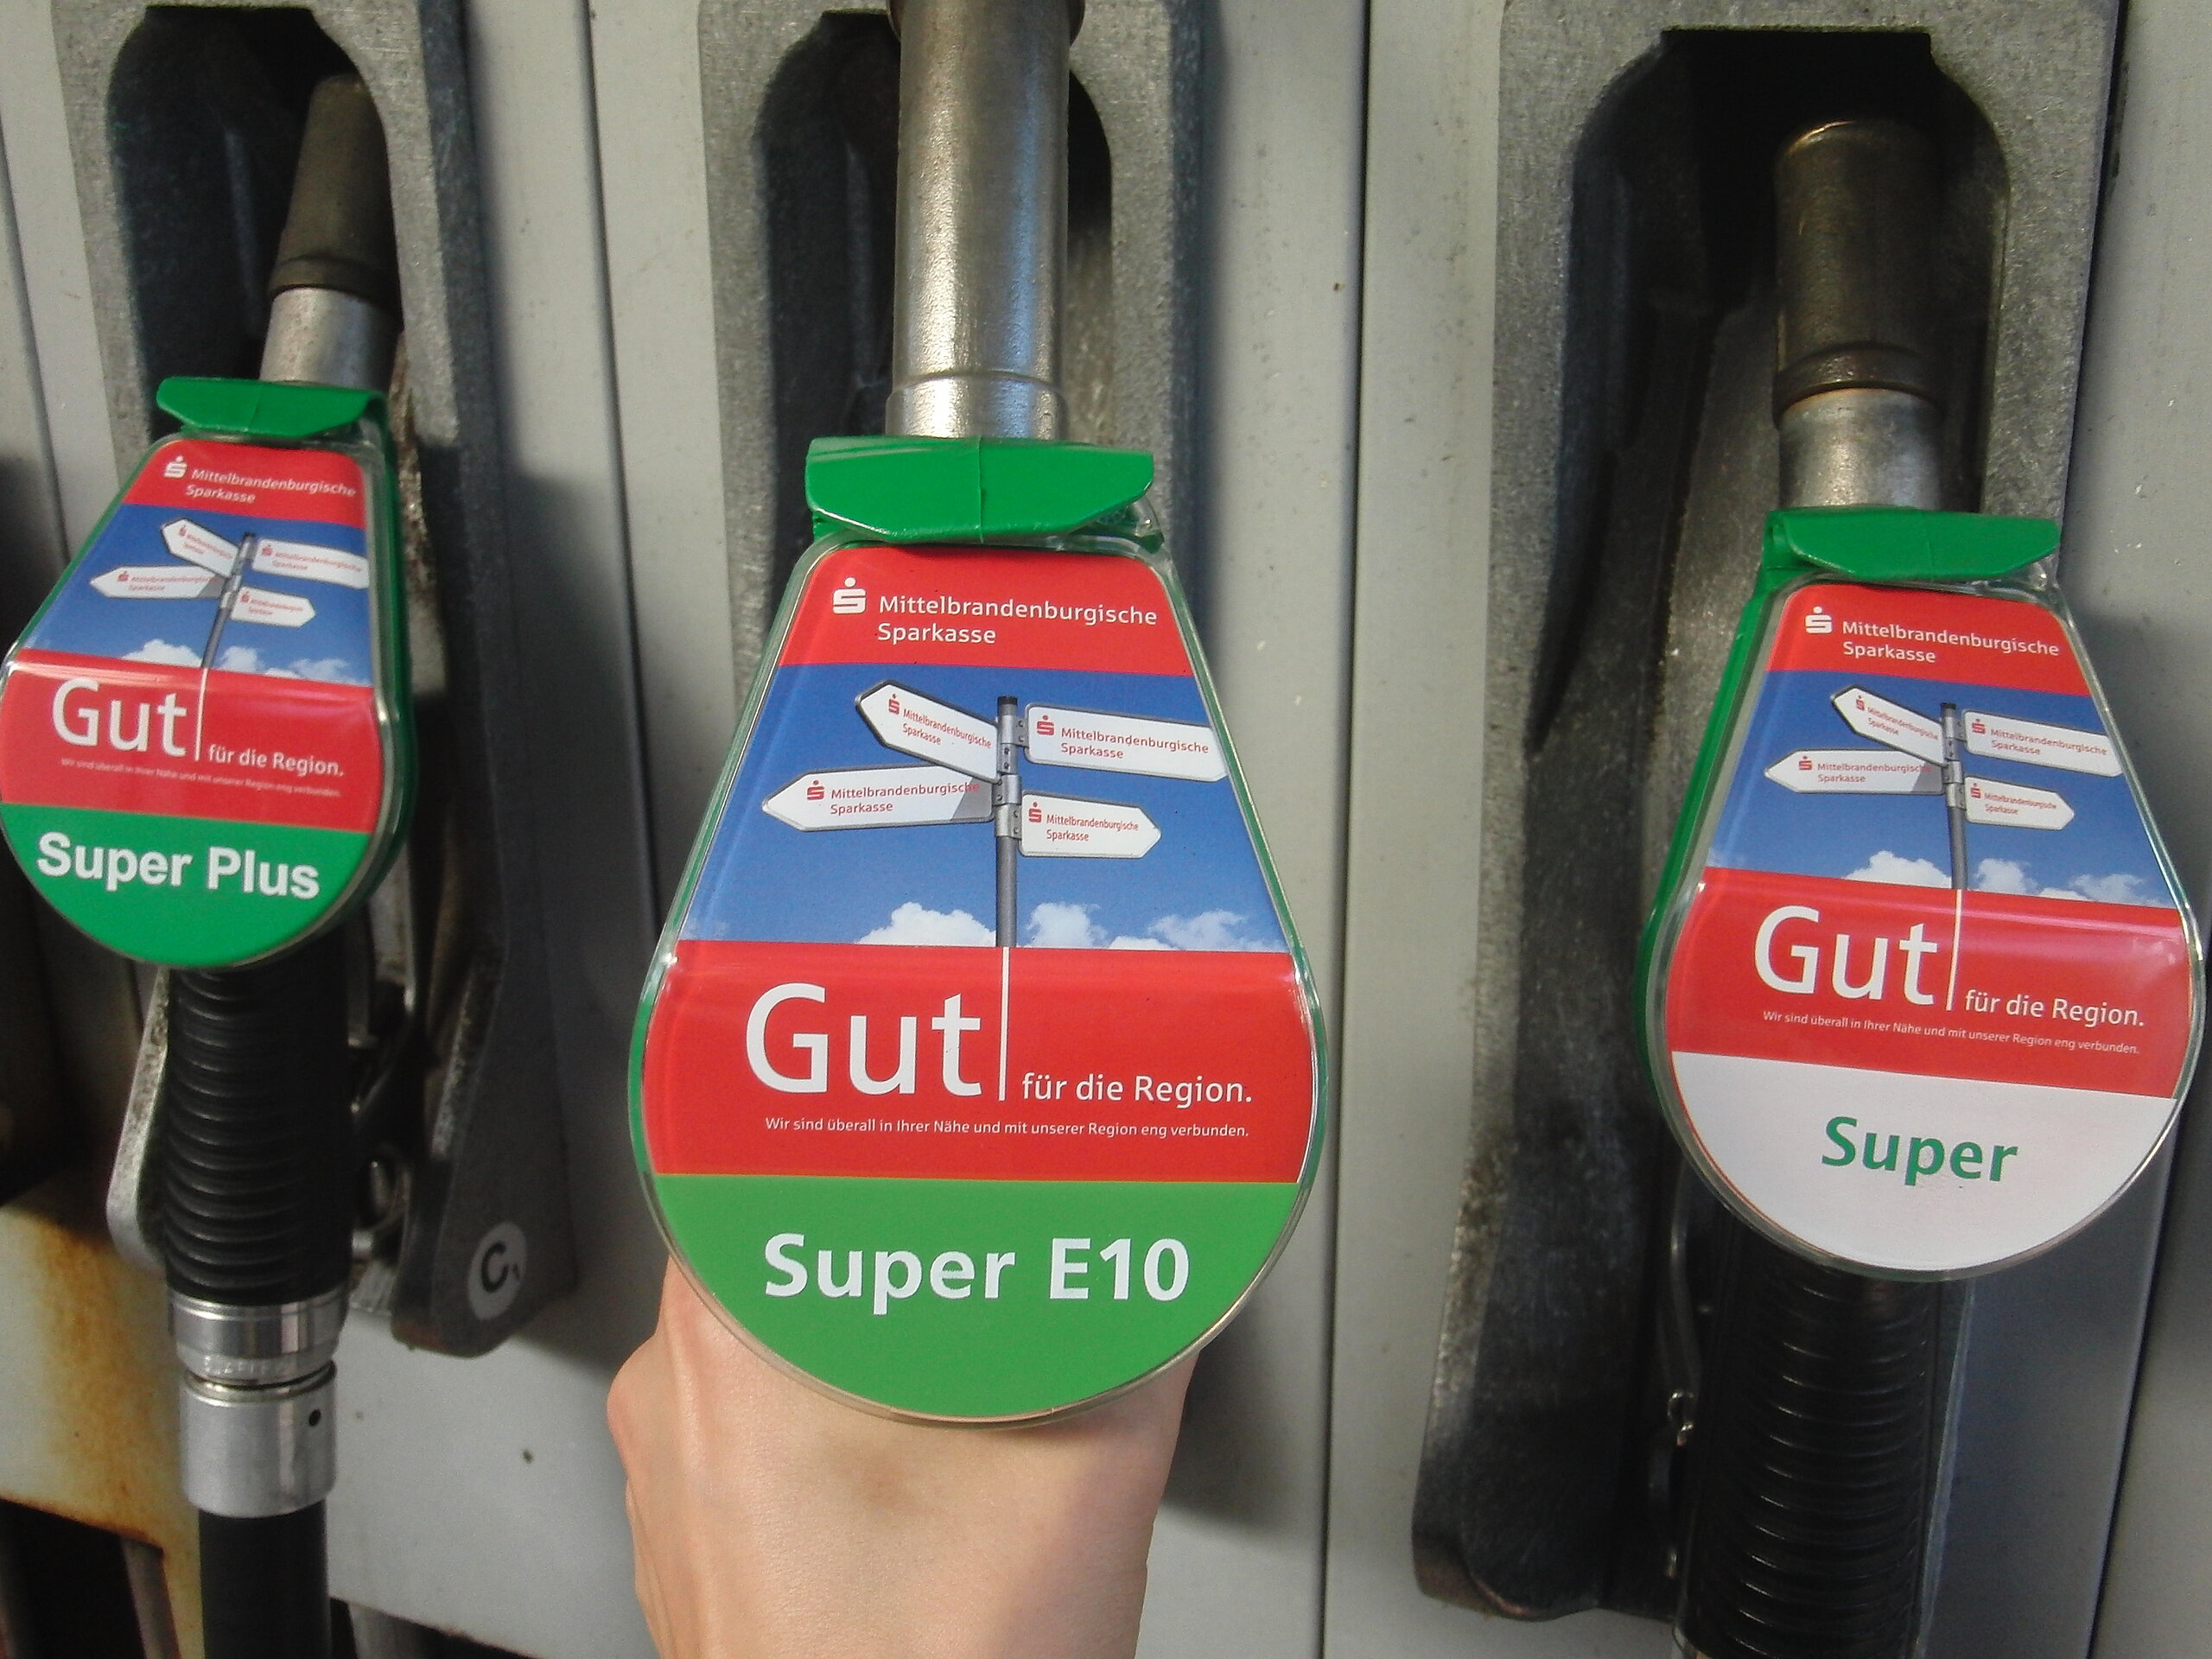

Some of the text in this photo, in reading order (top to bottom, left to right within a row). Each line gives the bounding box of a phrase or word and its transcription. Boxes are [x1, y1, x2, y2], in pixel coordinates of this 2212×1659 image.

[186, 484, 256, 503] Sparkasse
[192, 469, 356, 497] Mittelbrandenburgische
[879, 594, 1157, 627] Mittelbrandenburgische
[877, 622, 996, 645] Sparkasse
[1842, 620, 2060, 657] Mittelbrandenburgische
[1842, 641, 1936, 664] Sparkasse
[53, 677, 344, 777] Gut für die Region.
[902, 723, 941, 745] Sparkasse
[903, 709, 991, 748] Mittelbrandenburgische
[1061, 728, 1209, 753] Mittelbrandenburgische
[1061, 743, 1123, 759] Sparkasse
[1991, 729, 2107, 755] Mittelbrandenburgische
[1991, 740, 2041, 755] Sparkasse
[1817, 763, 1933, 773] Mittelbrandenburgische
[1817, 774, 1866, 783] Sparkasse
[831, 783, 980, 799] Mittelbrandenburgische
[830, 803, 893, 816] Sparkasse
[1046, 814, 1139, 831] Mittelbrandenburgische
[1046, 830, 1089, 842] Sparkasse
[37, 831, 320, 899] Super Plus
[1754, 905, 2145, 1027] Gut für die Region.
[1764, 1011, 2139, 1054] Wir sind überall in Ihrer Nähe und mit unserer Region eng verbunden.
[747, 982, 1252, 1109] Gut für die Region.
[766, 1117, 1249, 1139] Wir sind überall in Ihrer Nähe und mit unserer Region eng verbunden.
[1821, 1116, 2018, 1185] Super
[765, 1233, 1190, 1316] Super E10
